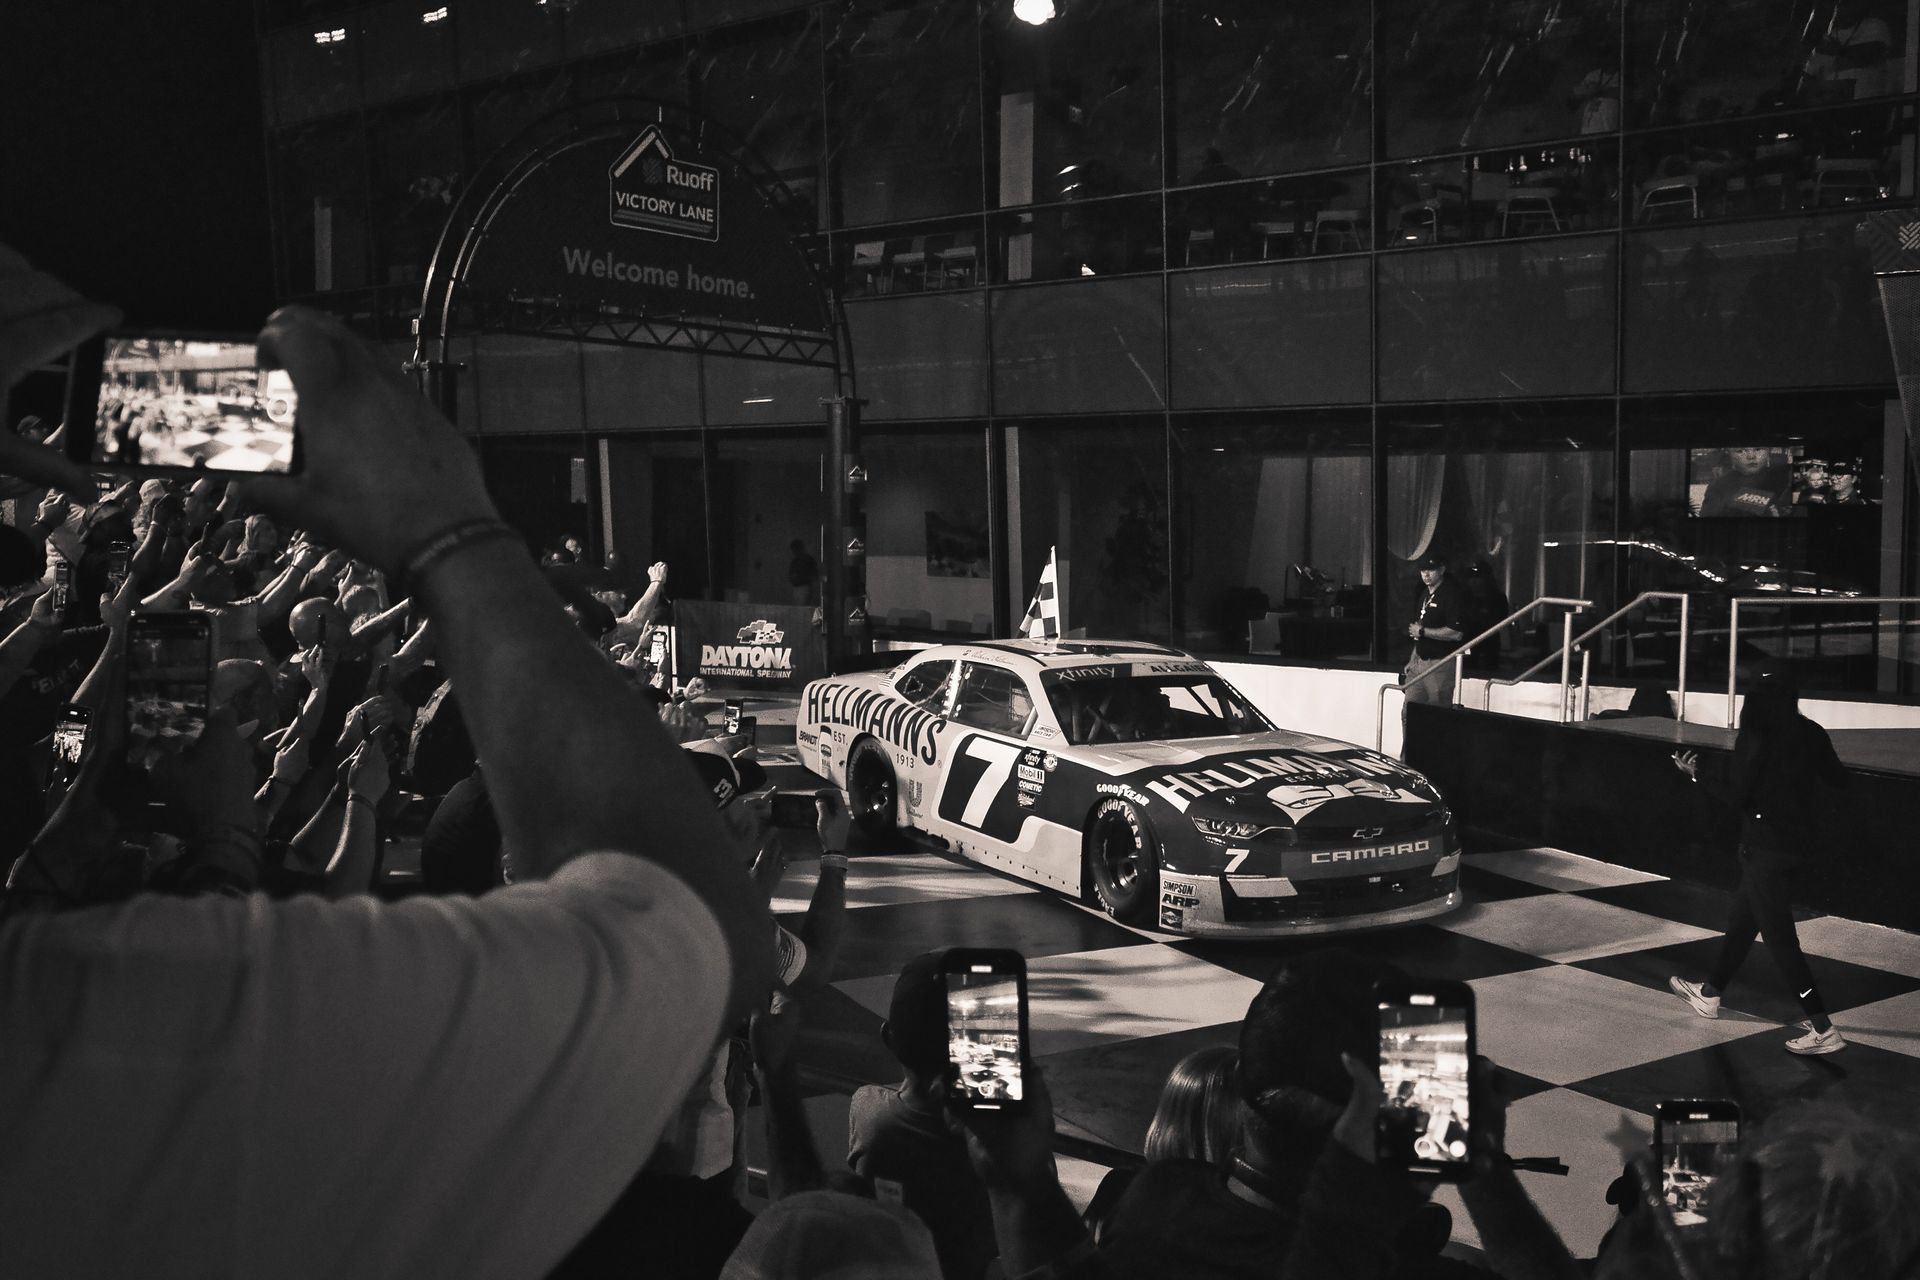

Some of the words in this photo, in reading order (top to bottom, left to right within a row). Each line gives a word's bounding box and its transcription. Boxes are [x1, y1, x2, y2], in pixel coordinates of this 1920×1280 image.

[666, 165, 714, 191] Ruoff
[616, 191, 676, 215] VICTORY
[680, 203, 714, 223] LANE
[562, 246, 679, 287] Welcome
[687, 264, 755, 299] home.
[700, 645, 792, 669] DAYTONA
[699, 667, 754, 677] INTERNATIONAL
[757, 669, 792, 679] SPEEDWAY
[833, 730, 848, 746] EST.
[896, 753, 915, 768] 1913
[961, 736, 1022, 829] 7
[1096, 783, 1150, 806] GOODYEAR
[1223, 848, 1250, 873] 7
[1311, 840, 1430, 864] CAMARO
[1162, 881, 1194, 895] SIMPSON
[1162, 893, 1200, 907] ARP
